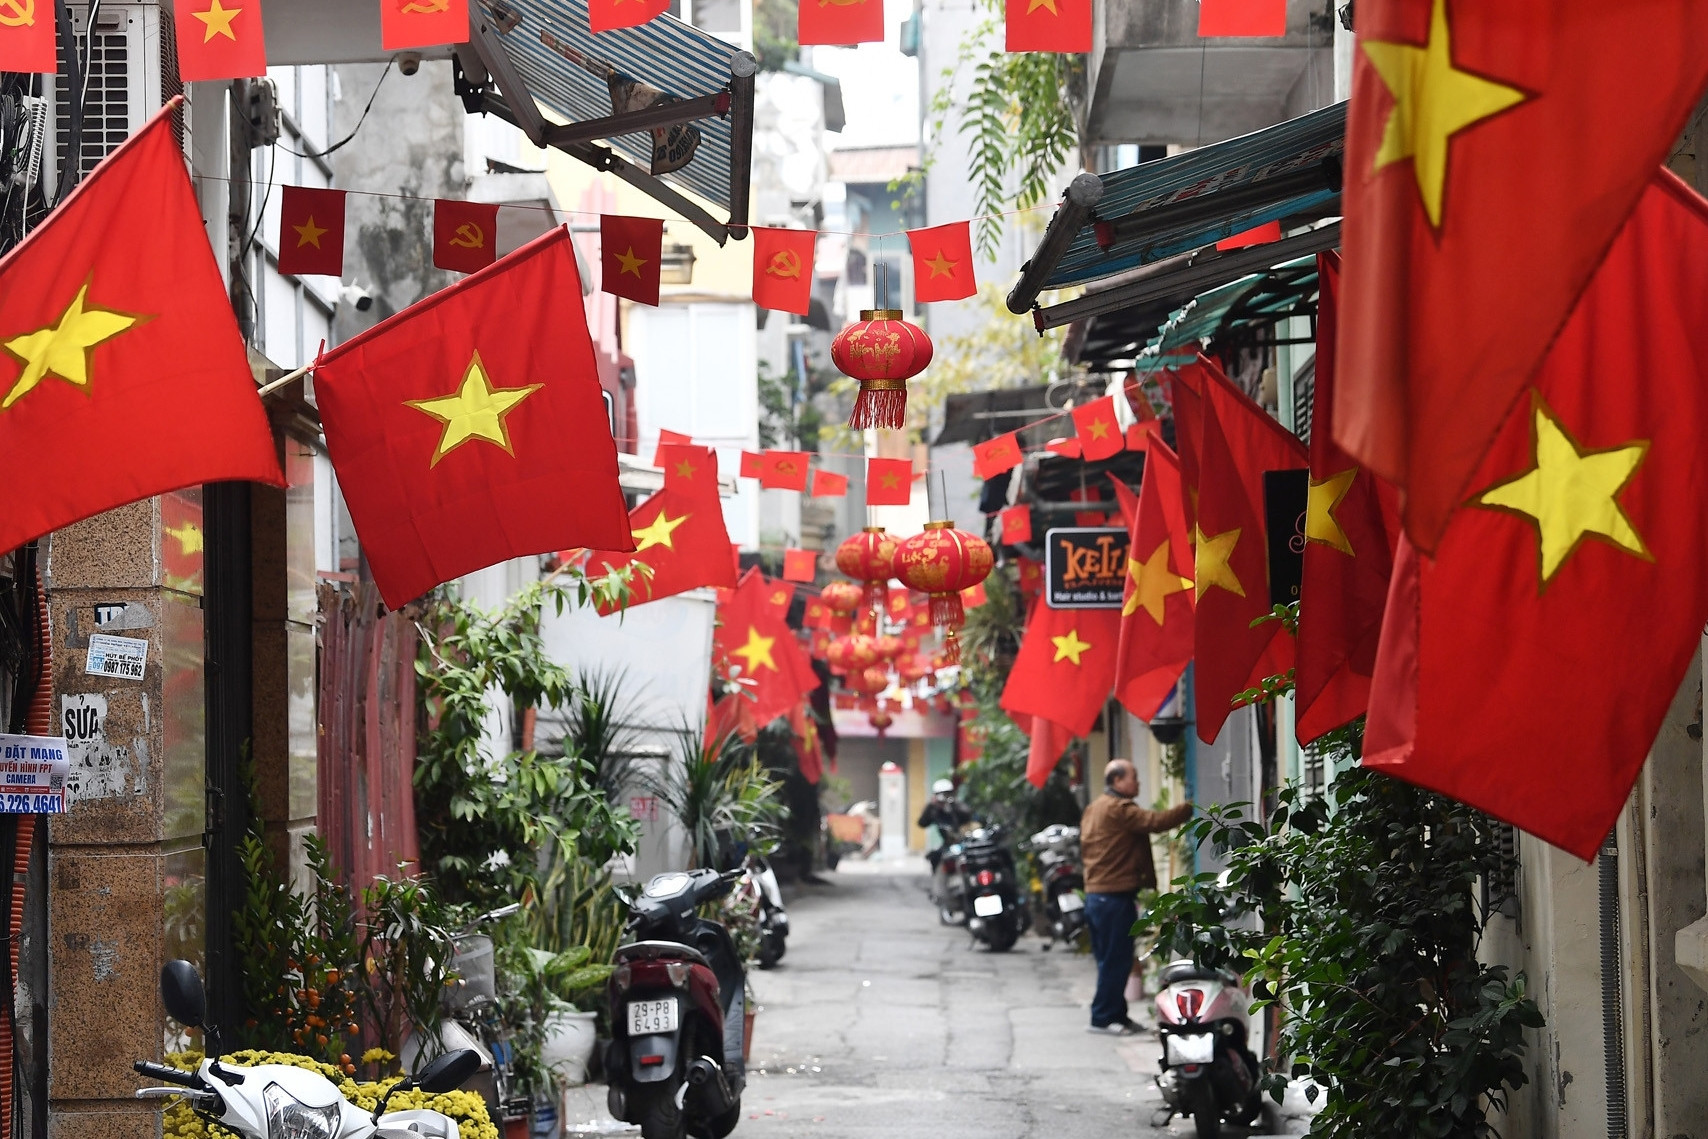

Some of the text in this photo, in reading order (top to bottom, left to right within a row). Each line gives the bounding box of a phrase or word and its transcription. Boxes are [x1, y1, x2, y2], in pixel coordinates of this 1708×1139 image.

[5, 744, 27, 761] ĐẶT
[30, 747, 63, 762] MẠNG
[20, 761, 38, 773] HÌNH
[39, 763, 53, 773] FPT
[6, 774, 36, 784] CAMERA
[634, 1001, 670, 1018] 29-P8
